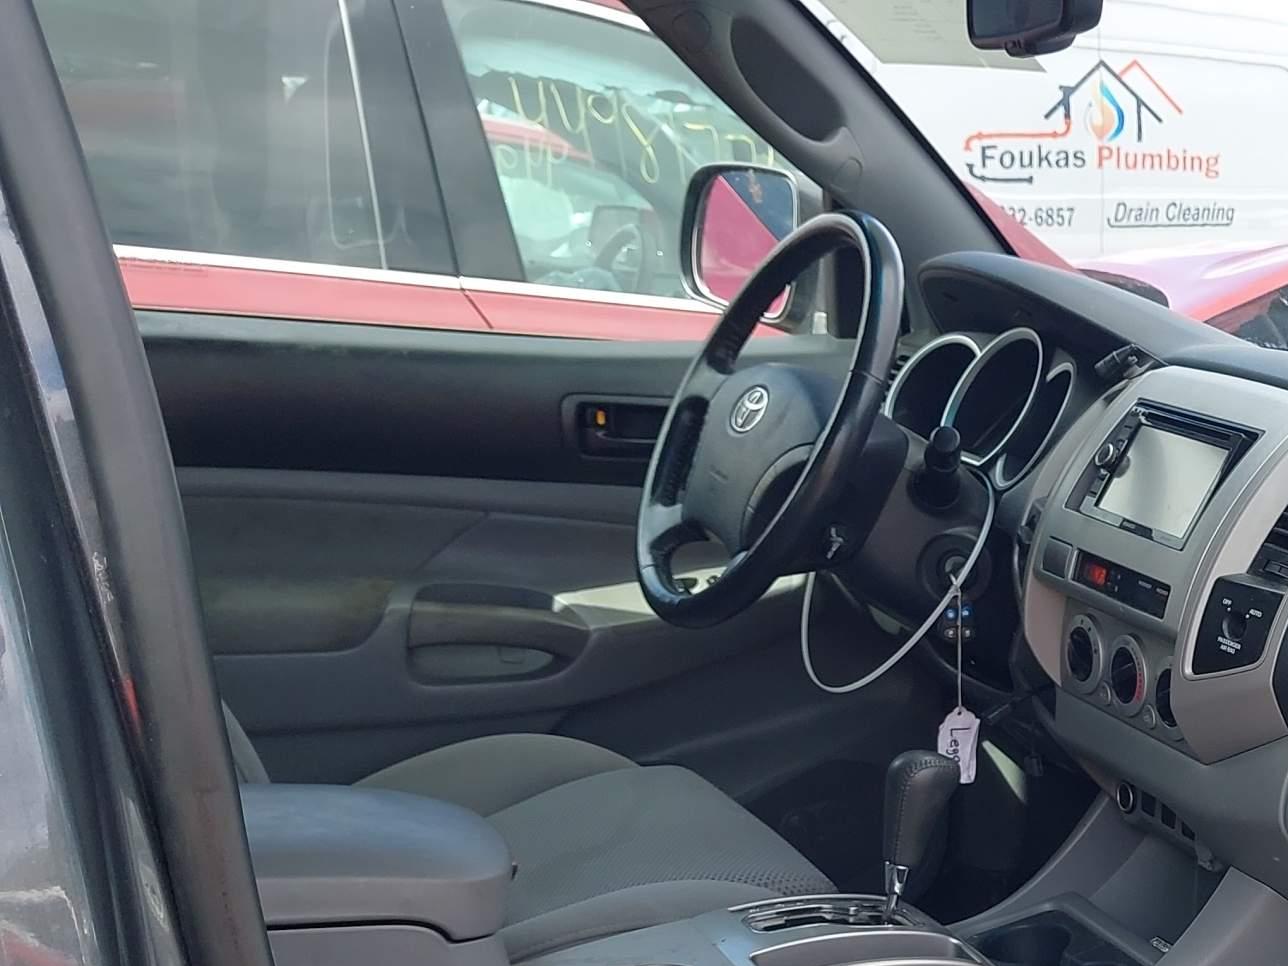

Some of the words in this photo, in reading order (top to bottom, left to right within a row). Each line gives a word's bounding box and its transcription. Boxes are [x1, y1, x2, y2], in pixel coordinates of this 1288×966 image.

[981, 144, 1086, 169] Foukas
[1097, 145, 1220, 178] Plumbing
[1114, 201, 1160, 223] Drain
[1165, 201, 1236, 226] Cleaning
[1249, 608, 1263, 618] AUTO
